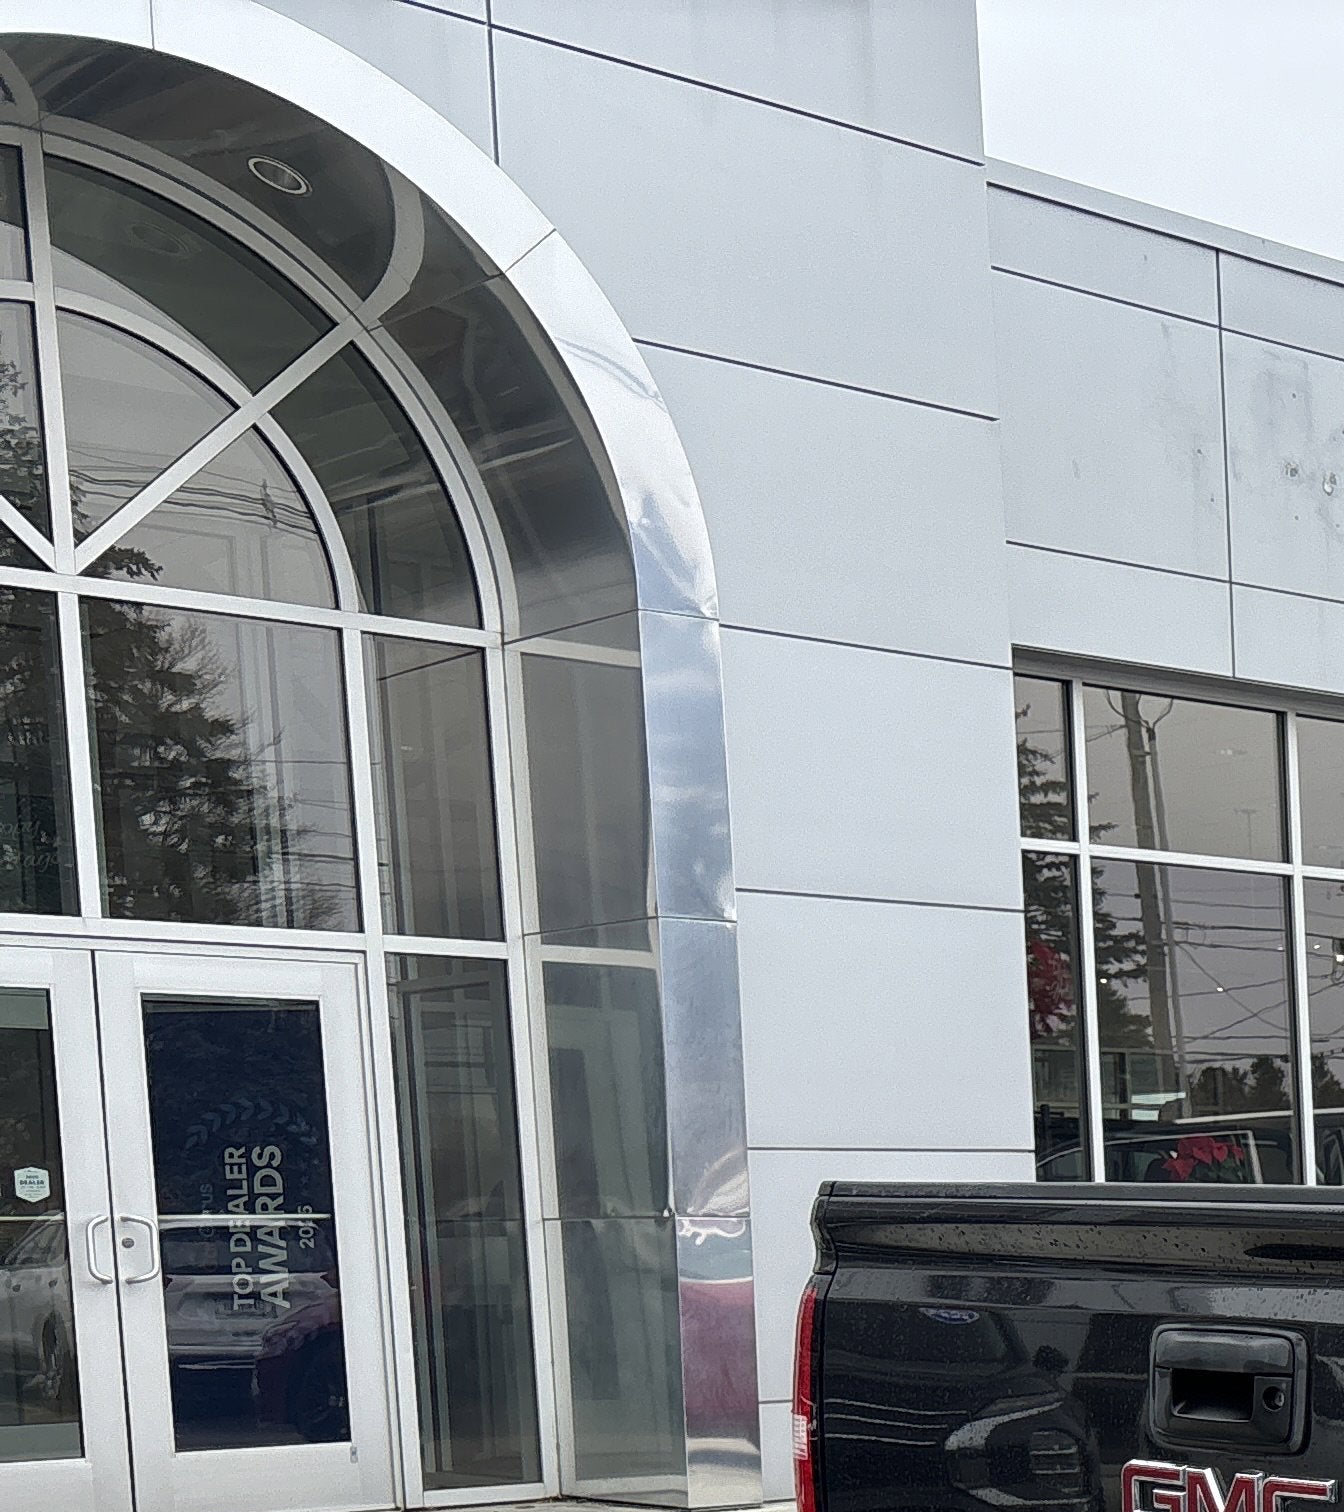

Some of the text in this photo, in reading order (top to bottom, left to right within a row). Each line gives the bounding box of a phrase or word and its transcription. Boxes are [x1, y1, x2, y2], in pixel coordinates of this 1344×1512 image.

[223, 1145, 256, 1311] TOP DEALER
[250, 1143, 292, 1310] AWARDS
[297, 1204, 316, 1250] 205
